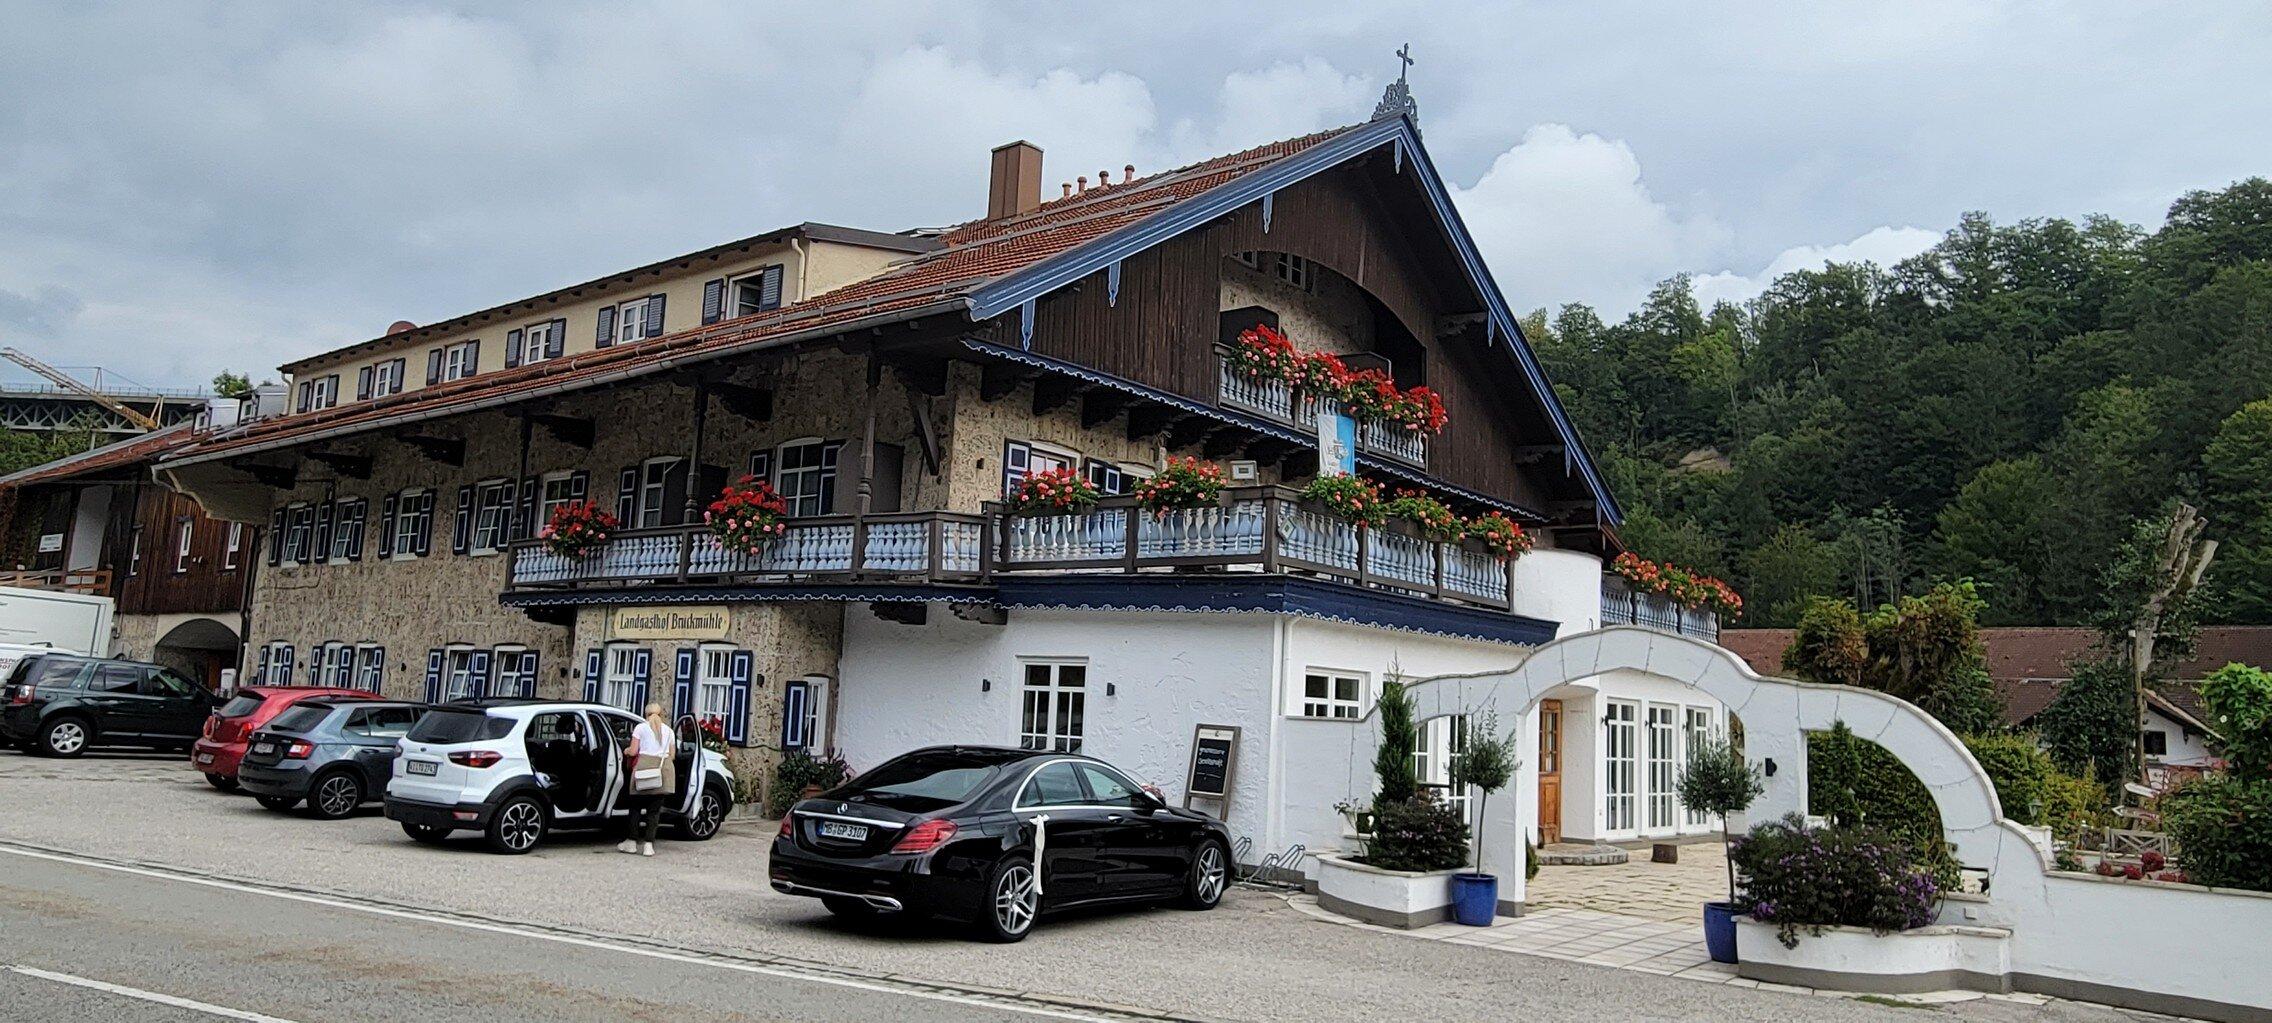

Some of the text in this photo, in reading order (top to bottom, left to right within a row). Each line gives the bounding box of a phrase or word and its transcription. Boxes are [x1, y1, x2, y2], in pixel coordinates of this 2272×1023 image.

[620, 612, 723, 631] Landgasthof Bruckmühle
[847, 825, 867, 839] 3107
